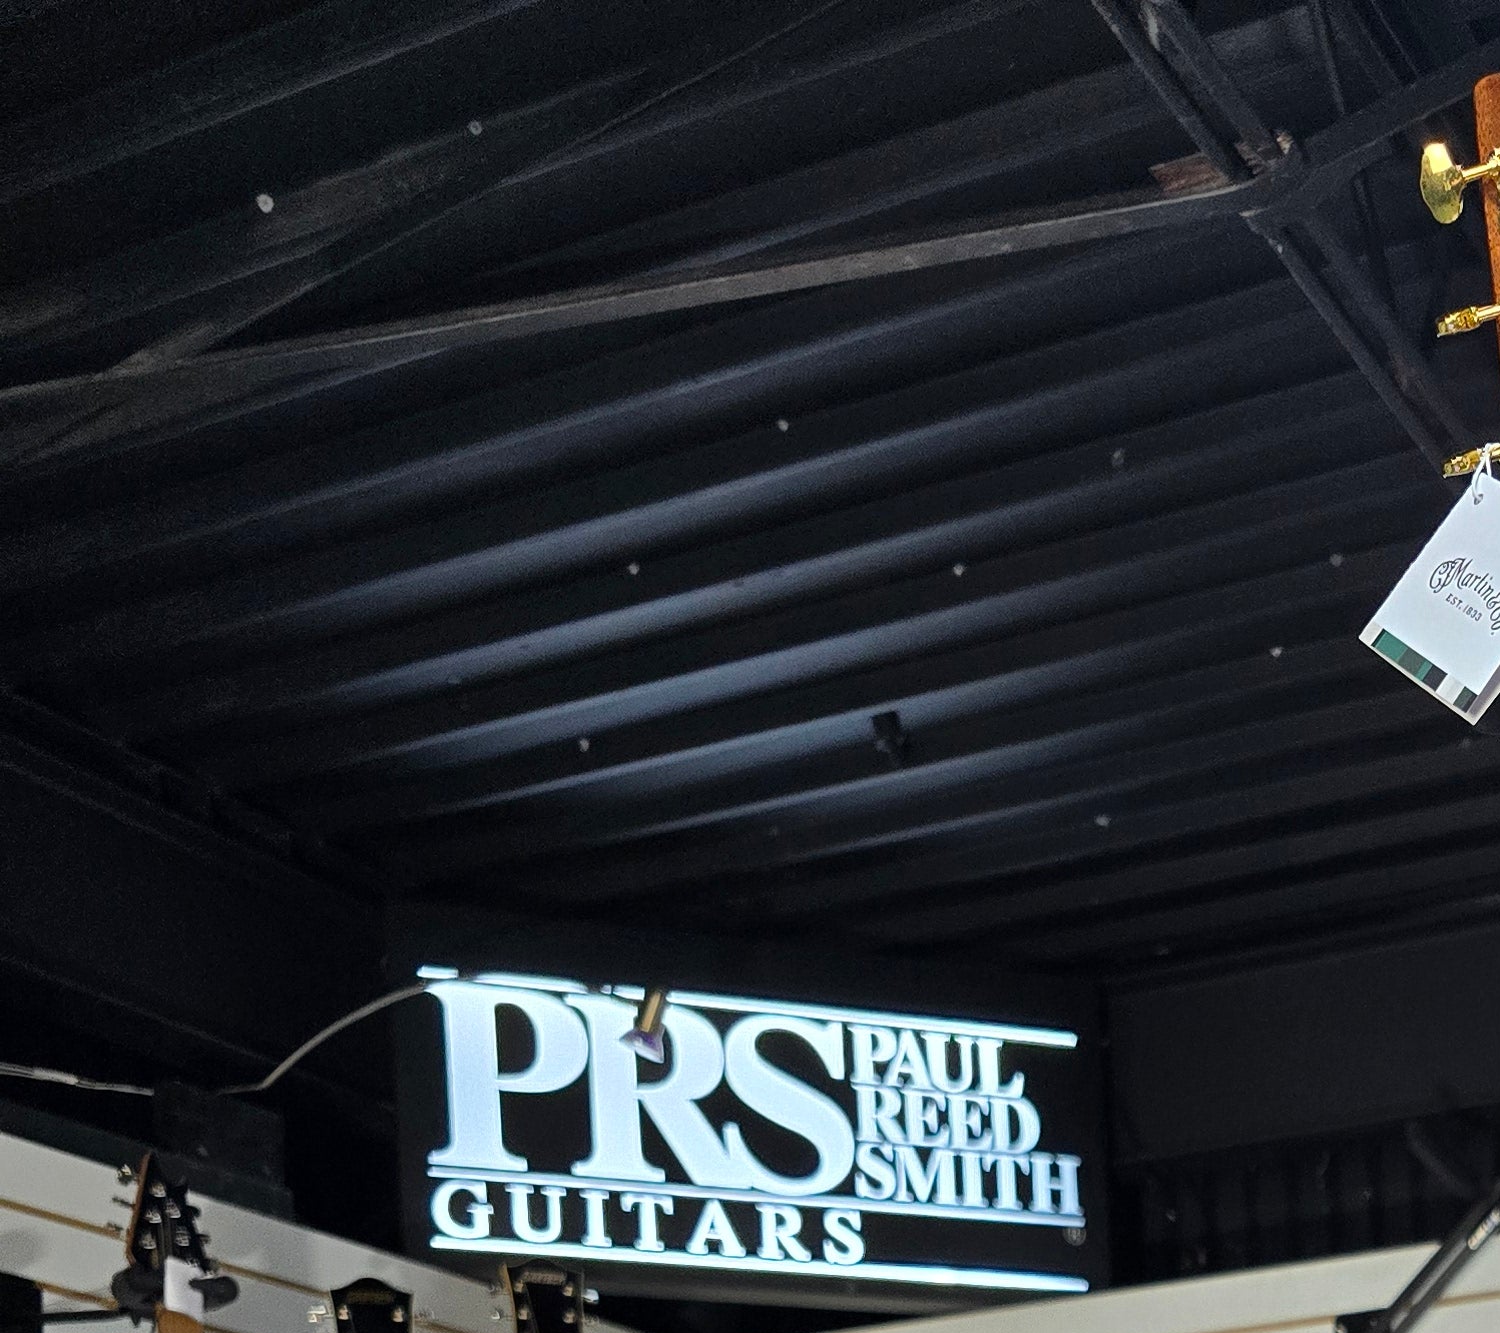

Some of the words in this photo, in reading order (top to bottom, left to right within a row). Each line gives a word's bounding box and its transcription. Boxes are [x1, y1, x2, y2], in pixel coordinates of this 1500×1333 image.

[1445, 592, 1464, 611] EST.
[1463, 603, 1483, 623] 1833
[425, 979, 857, 1196] PRS
[845, 1022, 1025, 1098] PAUL
[852, 1082, 1042, 1154] REED
[853, 1141, 1086, 1216] SMITH
[430, 1179, 867, 1266] GUITARS
